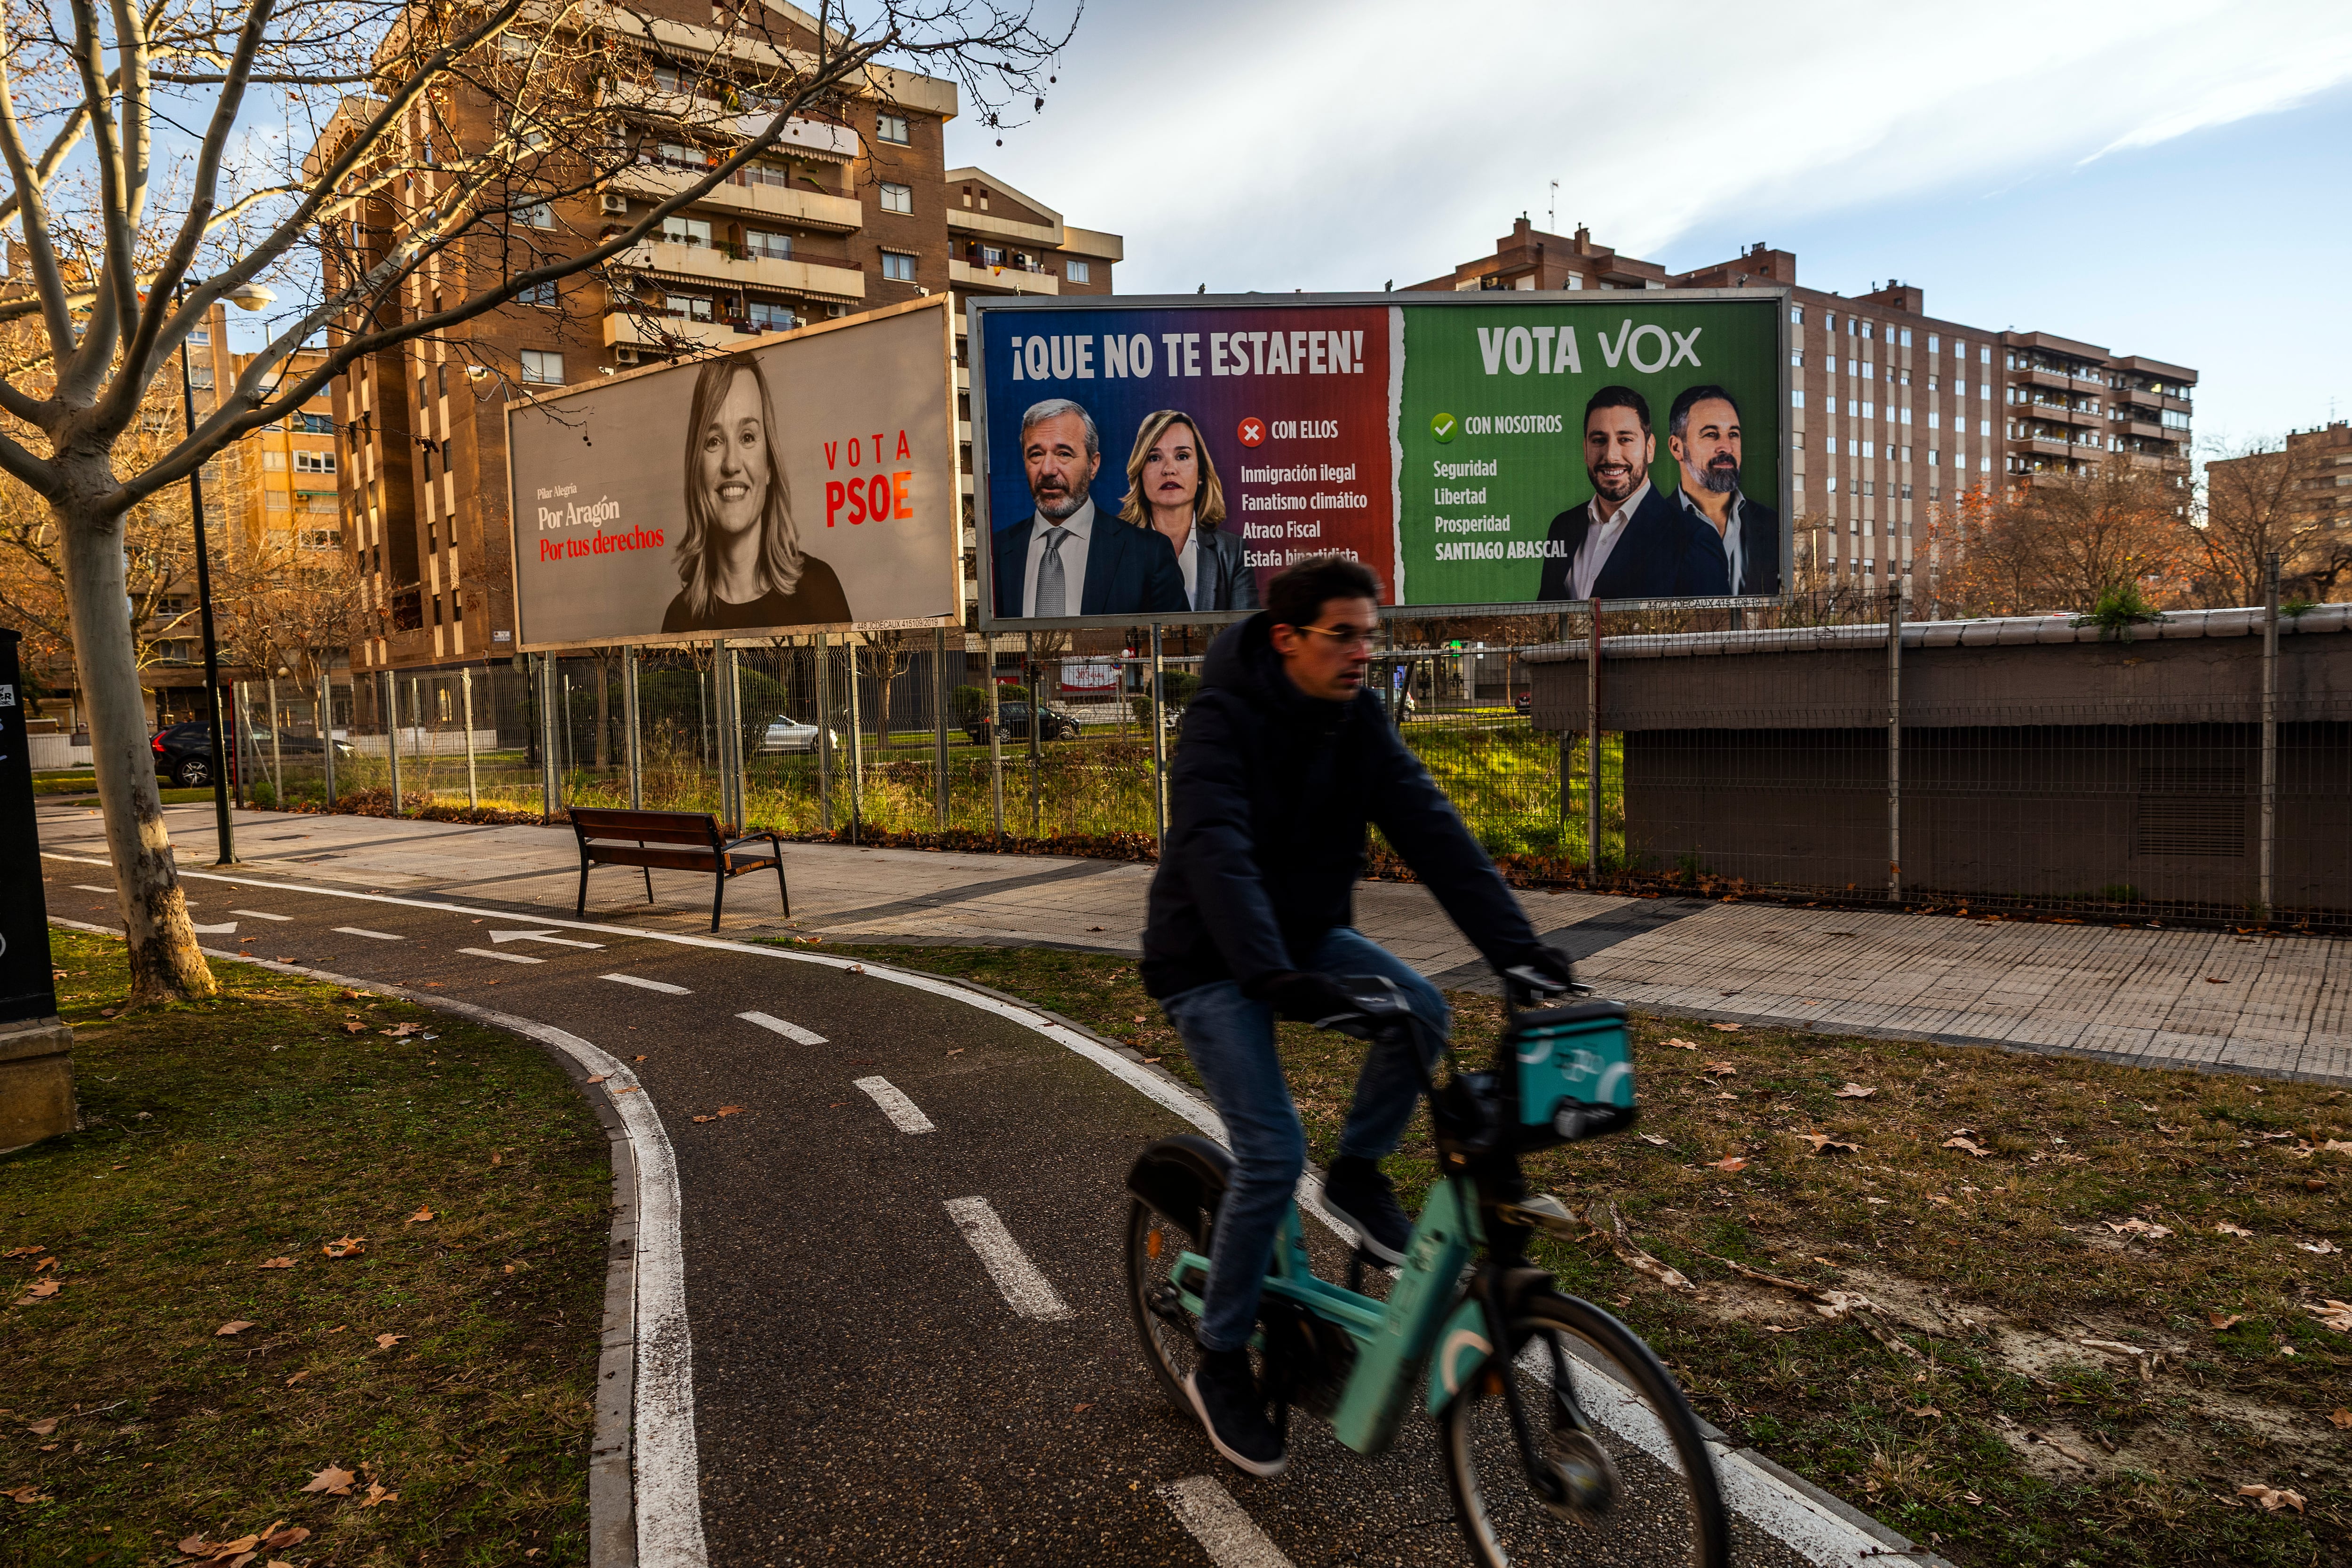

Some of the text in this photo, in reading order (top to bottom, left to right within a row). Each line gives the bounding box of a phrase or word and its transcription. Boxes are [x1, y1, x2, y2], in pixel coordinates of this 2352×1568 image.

[1012, 331, 1364, 380] ¡QUE NO TE ESTAFEN!
[1477, 319, 1702, 375] VOTA VOX
[1271, 420, 1338, 439] CON ELLOS
[1465, 415, 1562, 434] CON NOSOTROS
[824, 430, 911, 470] VOTA
[1241, 463, 1356, 485] Inmigración ilegal
[1433, 459, 1497, 479] Seguridad
[537, 483, 577, 500] Pilar Alegría
[826, 470, 913, 528] PSOE
[1242, 491, 1367, 511] Fanatismo climático
[1435, 487, 1486, 505] Libertad
[538, 494, 620, 530] Por Aragón
[1243, 520, 1320, 539] Atraco Fiscal
[1435, 514, 1510, 535] Prosperidad
[540, 524, 665, 562] Por tus derechos
[1435, 540, 1568, 561] SANTIAGO ABASCAL
[1244, 549, 1282, 567] Estafa
[1665, 600, 1713, 609] JCDECAUX
[869, 621, 901, 629] JCDECAUX
[902, 618, 938, 628] 415109/2019
